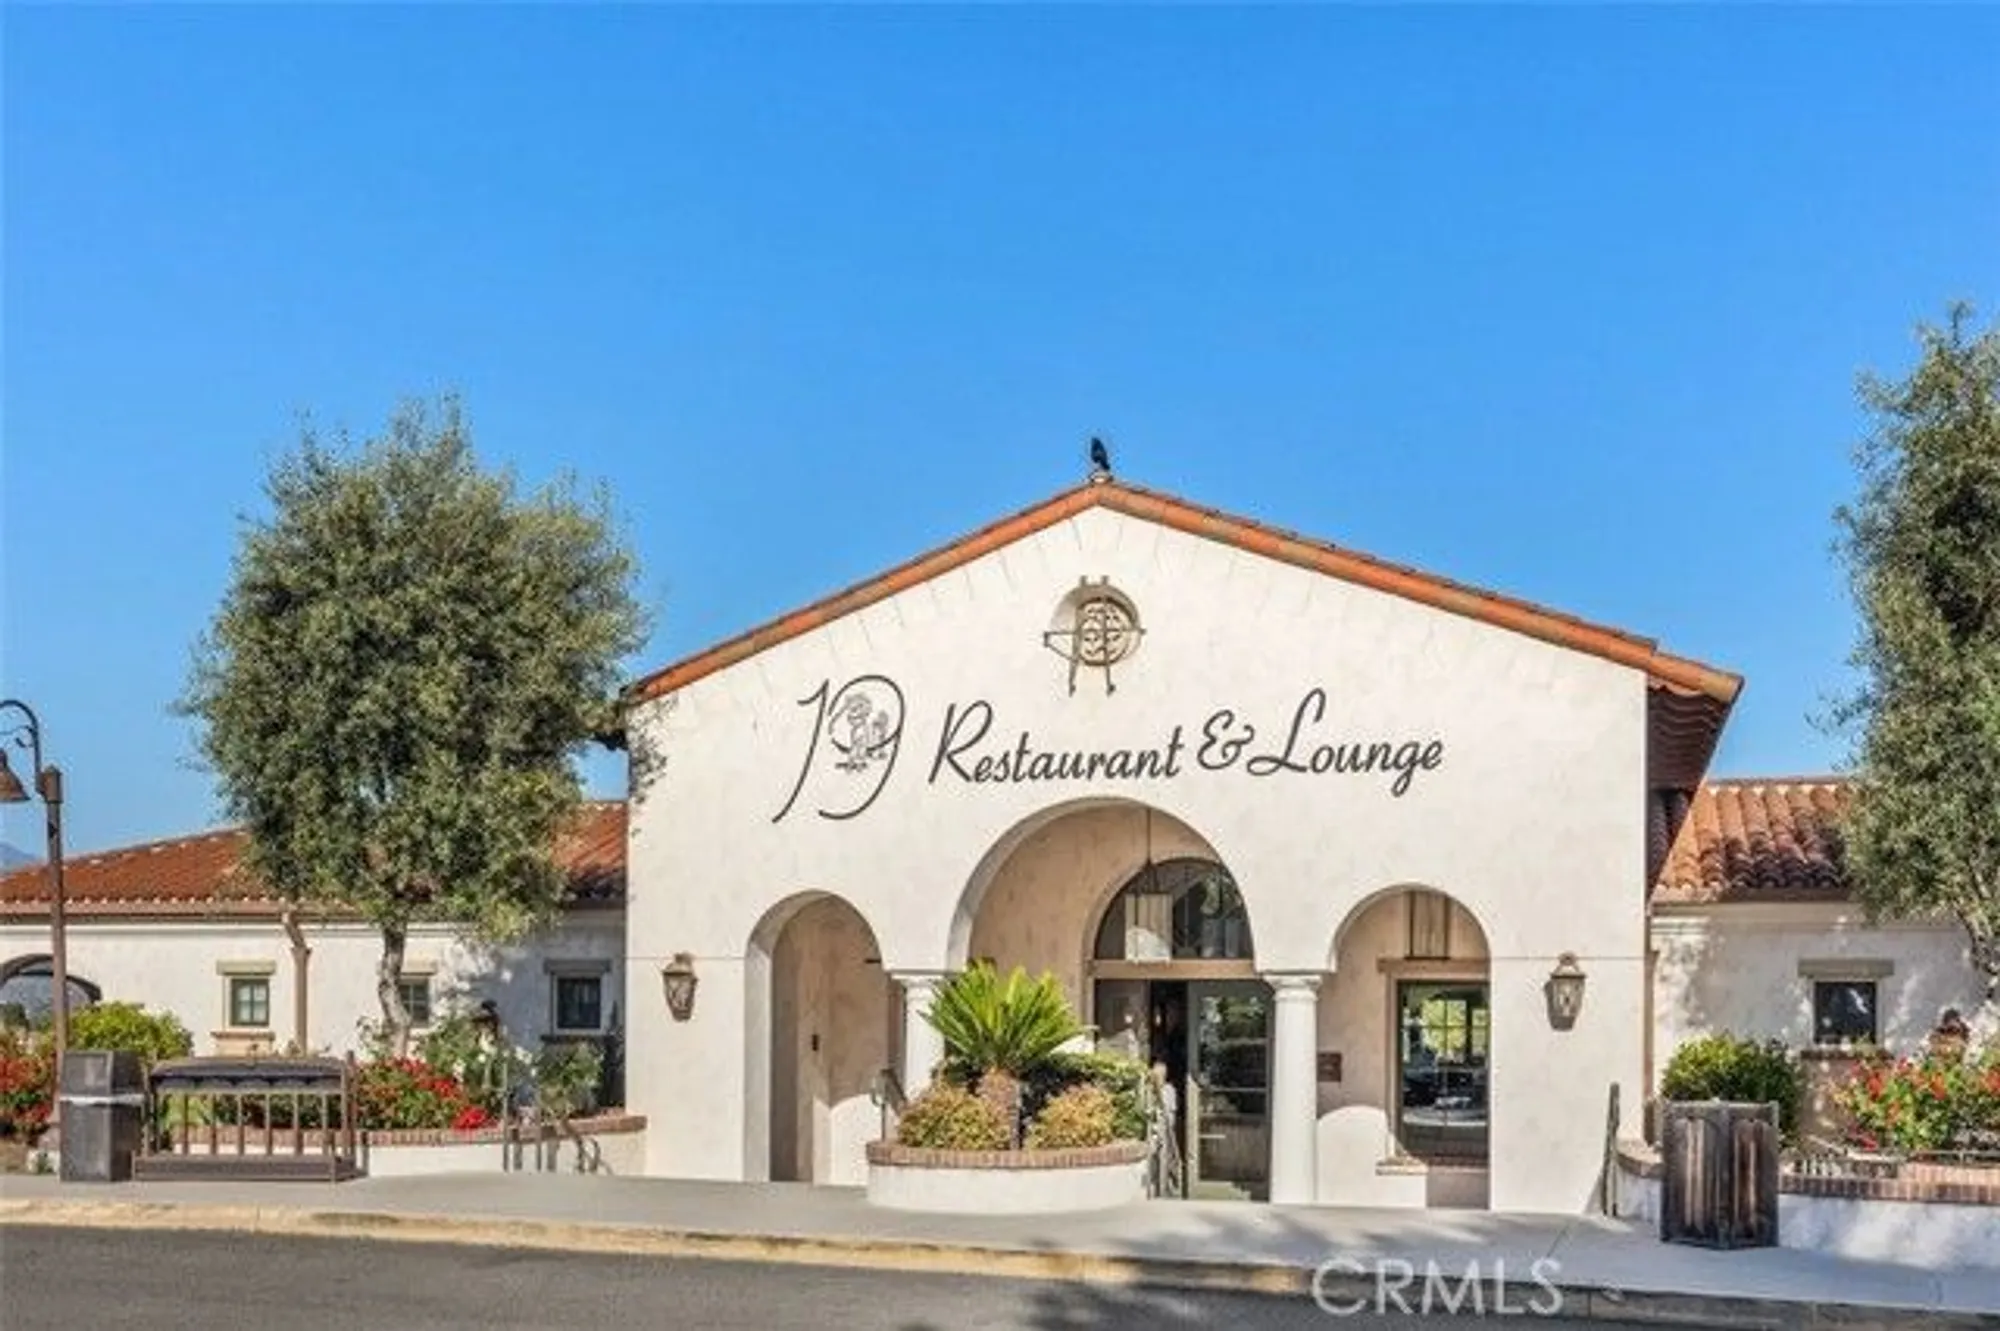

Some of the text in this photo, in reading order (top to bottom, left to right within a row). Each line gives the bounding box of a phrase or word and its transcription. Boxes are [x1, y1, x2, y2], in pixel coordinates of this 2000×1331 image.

[772, 675, 1442, 823] 19 Restaurant & Lounge
